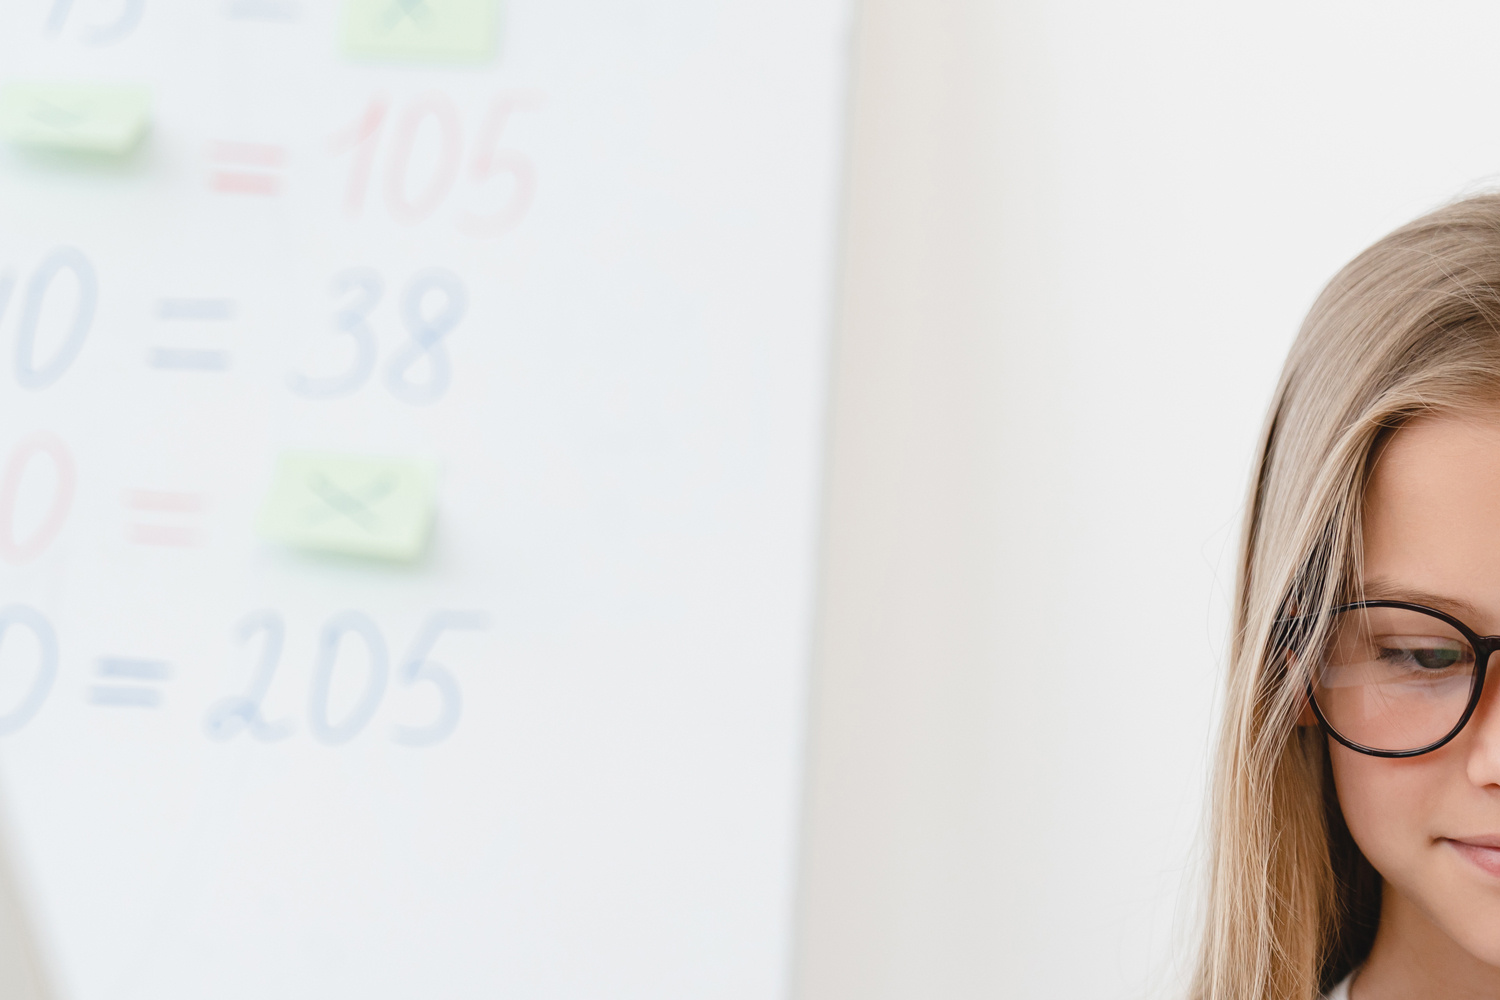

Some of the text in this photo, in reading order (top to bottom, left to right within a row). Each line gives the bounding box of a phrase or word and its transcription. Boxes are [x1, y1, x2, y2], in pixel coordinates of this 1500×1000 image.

[326, 88, 552, 238] 105
[284, 265, 470, 404] 38
[0, 428, 78, 567] 0
[204, 607, 492, 748] 205
